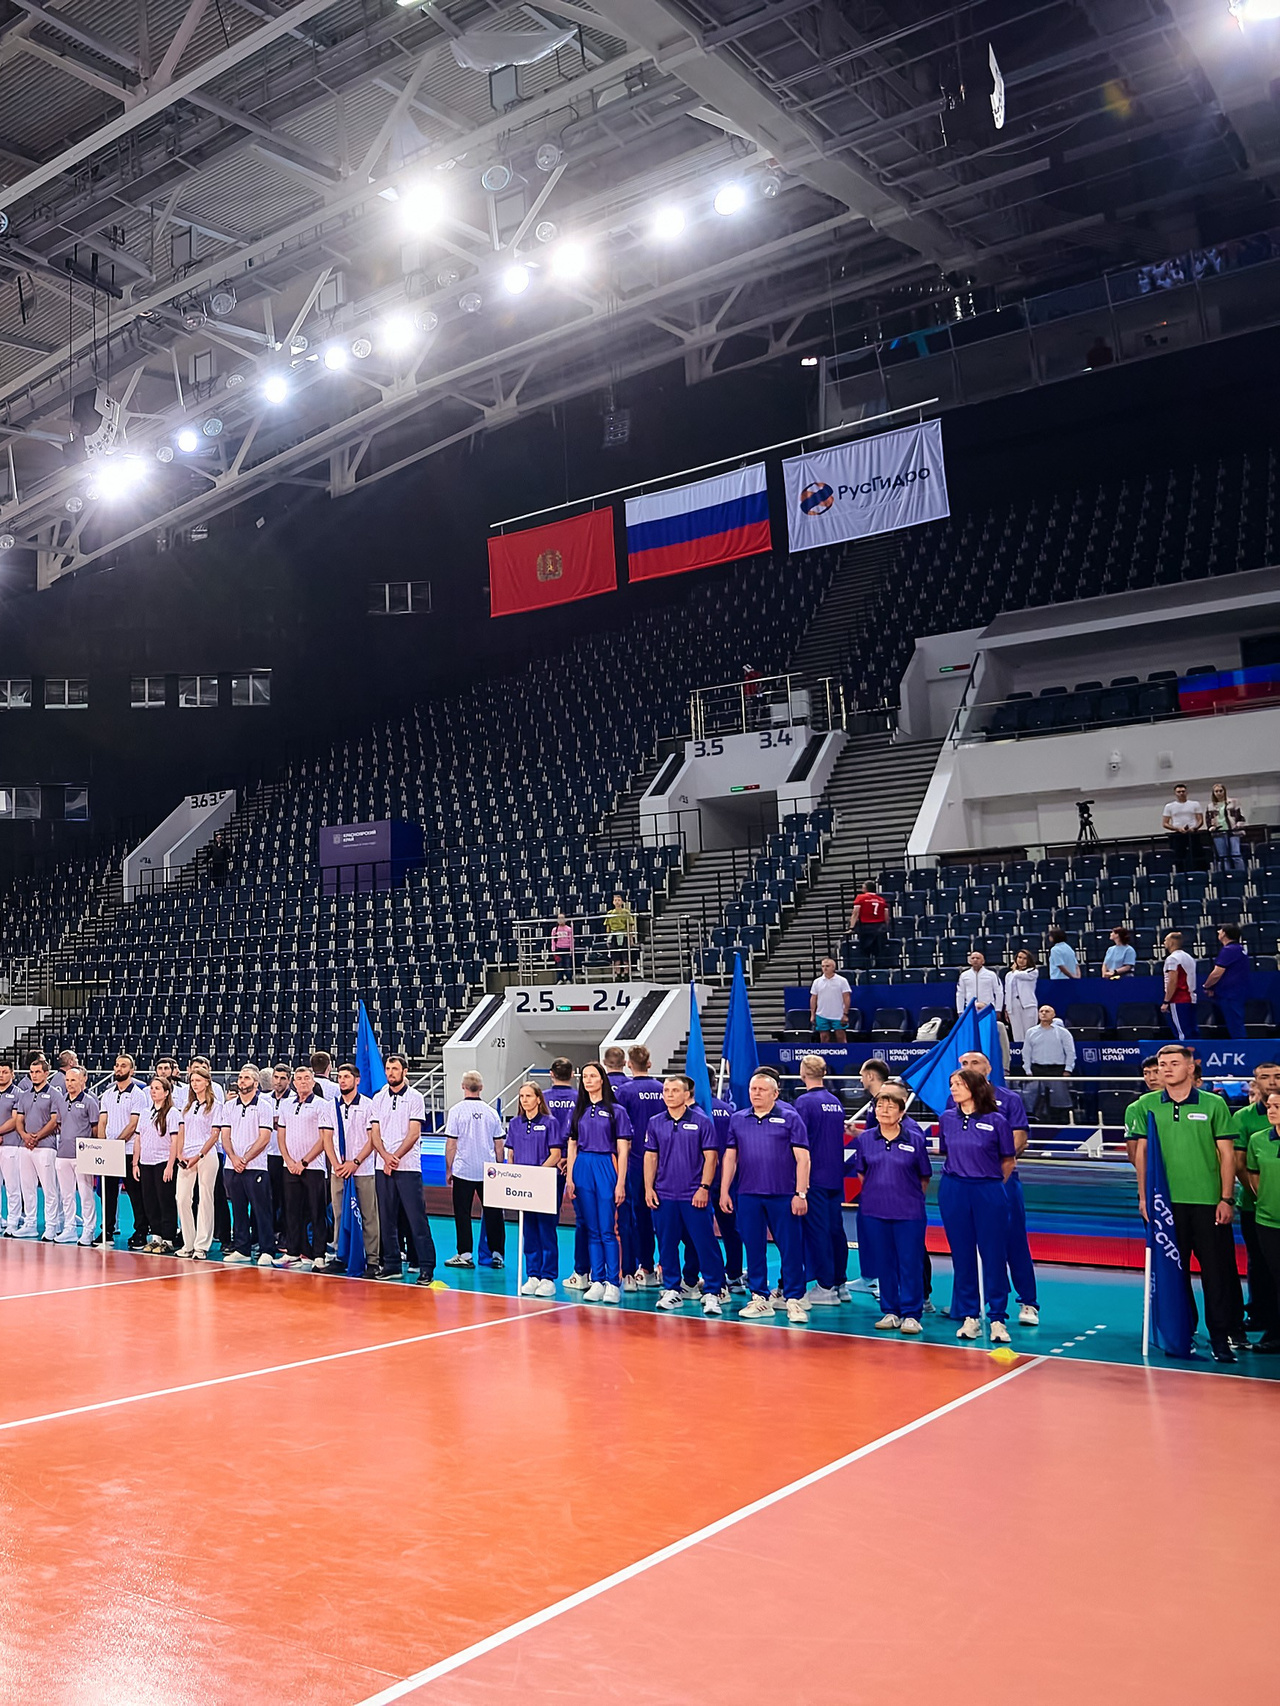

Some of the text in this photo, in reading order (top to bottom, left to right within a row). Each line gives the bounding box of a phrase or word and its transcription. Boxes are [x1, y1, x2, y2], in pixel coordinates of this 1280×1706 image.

[837, 467, 931, 501] РусГидро
[694, 729, 793, 758] 3.5 3.4
[190, 795, 208, 809] 3.6
[871, 902, 880, 915] 7
[516, 989, 631, 1013] 2.5 2.4
[496, 1037, 506, 1048] 25
[1101, 1047, 1140, 1055] КРАСНОЯ
[1101, 1054, 1125, 1062] КРАЙ
[1206, 1052, 1246, 1067] ДГК
[639, 1092, 663, 1100] ВОЛГА
[548, 1100, 576, 1108] ВОЛГА
[821, 1103, 843, 1113] ВОЛГА
[472, 1112, 483, 1120] ЮГ
[712, 1109, 730, 1117] ЛГА
[95, 1157, 105, 1165] Юг
[497, 1170, 522, 1179] РусГидро
[505, 1187, 533, 1198] Волга
